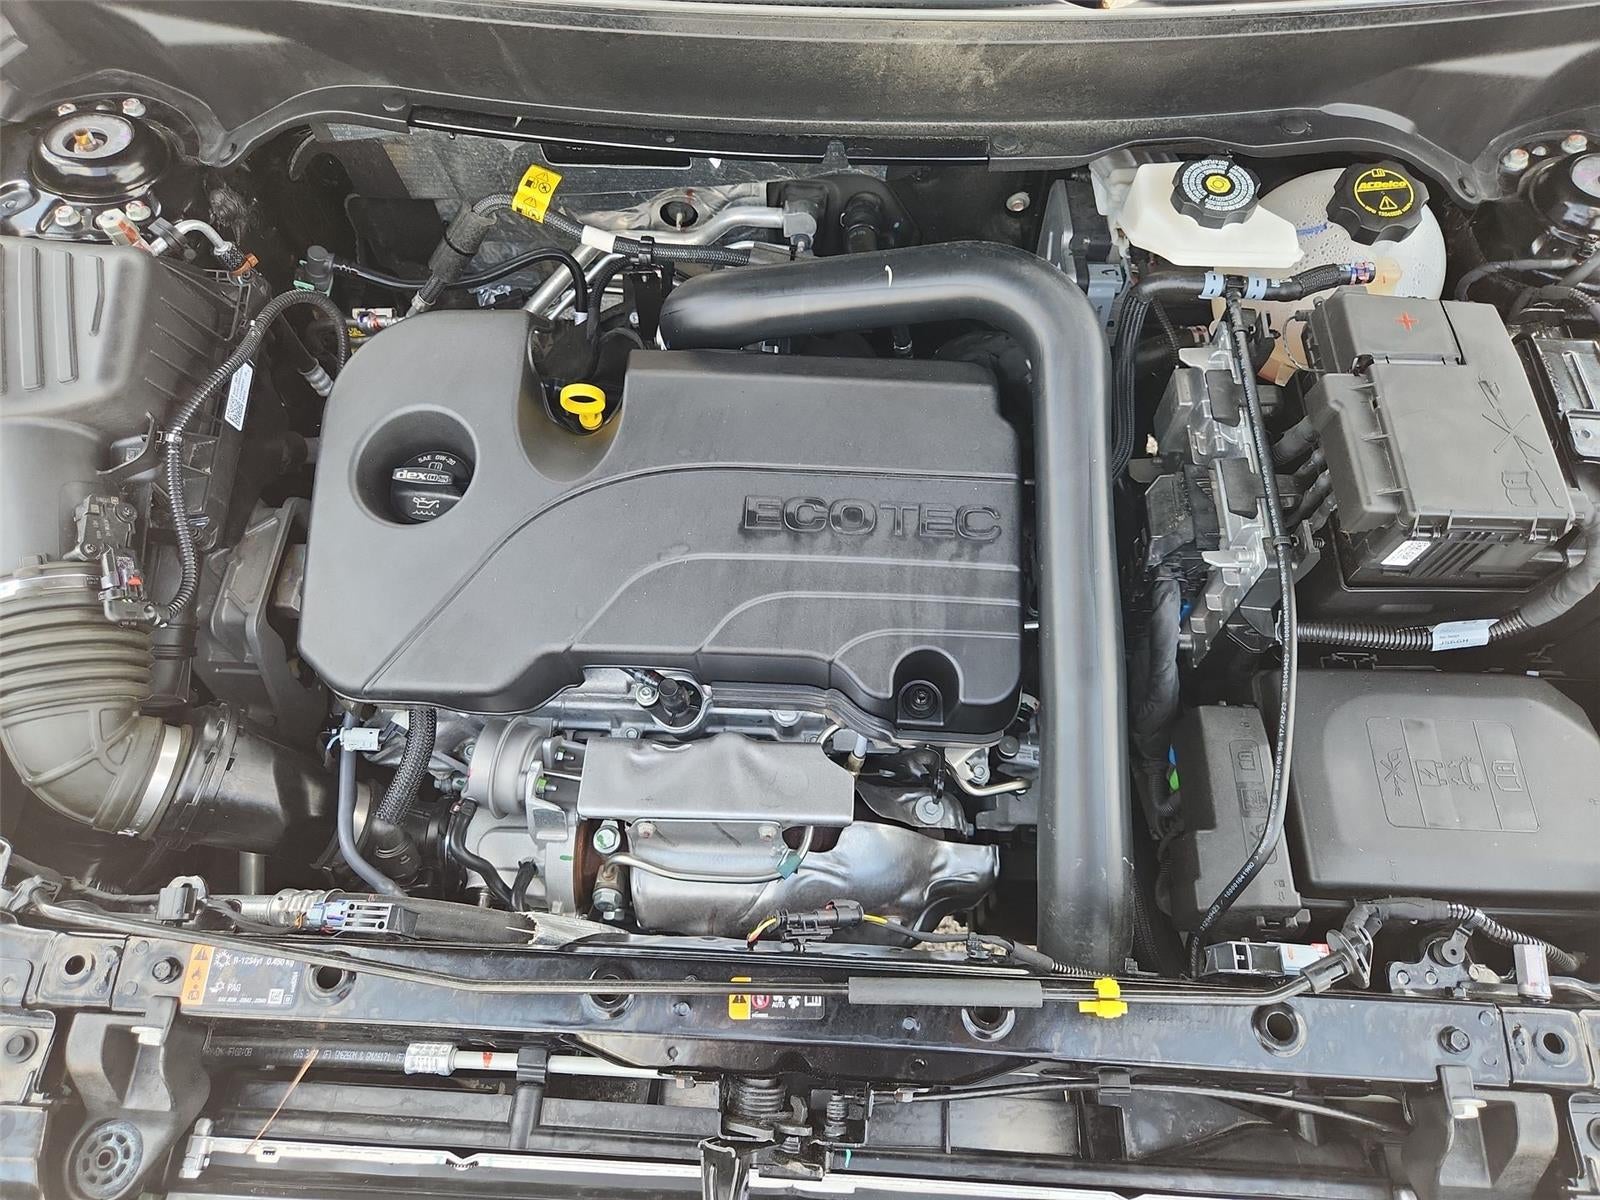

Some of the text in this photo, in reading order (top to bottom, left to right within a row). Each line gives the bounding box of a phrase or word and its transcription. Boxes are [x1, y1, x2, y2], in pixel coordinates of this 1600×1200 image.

[417, 455, 432, 464] SAE
[744, 496, 1001, 541] ECOTEC
[227, 983, 242, 992] PAG
